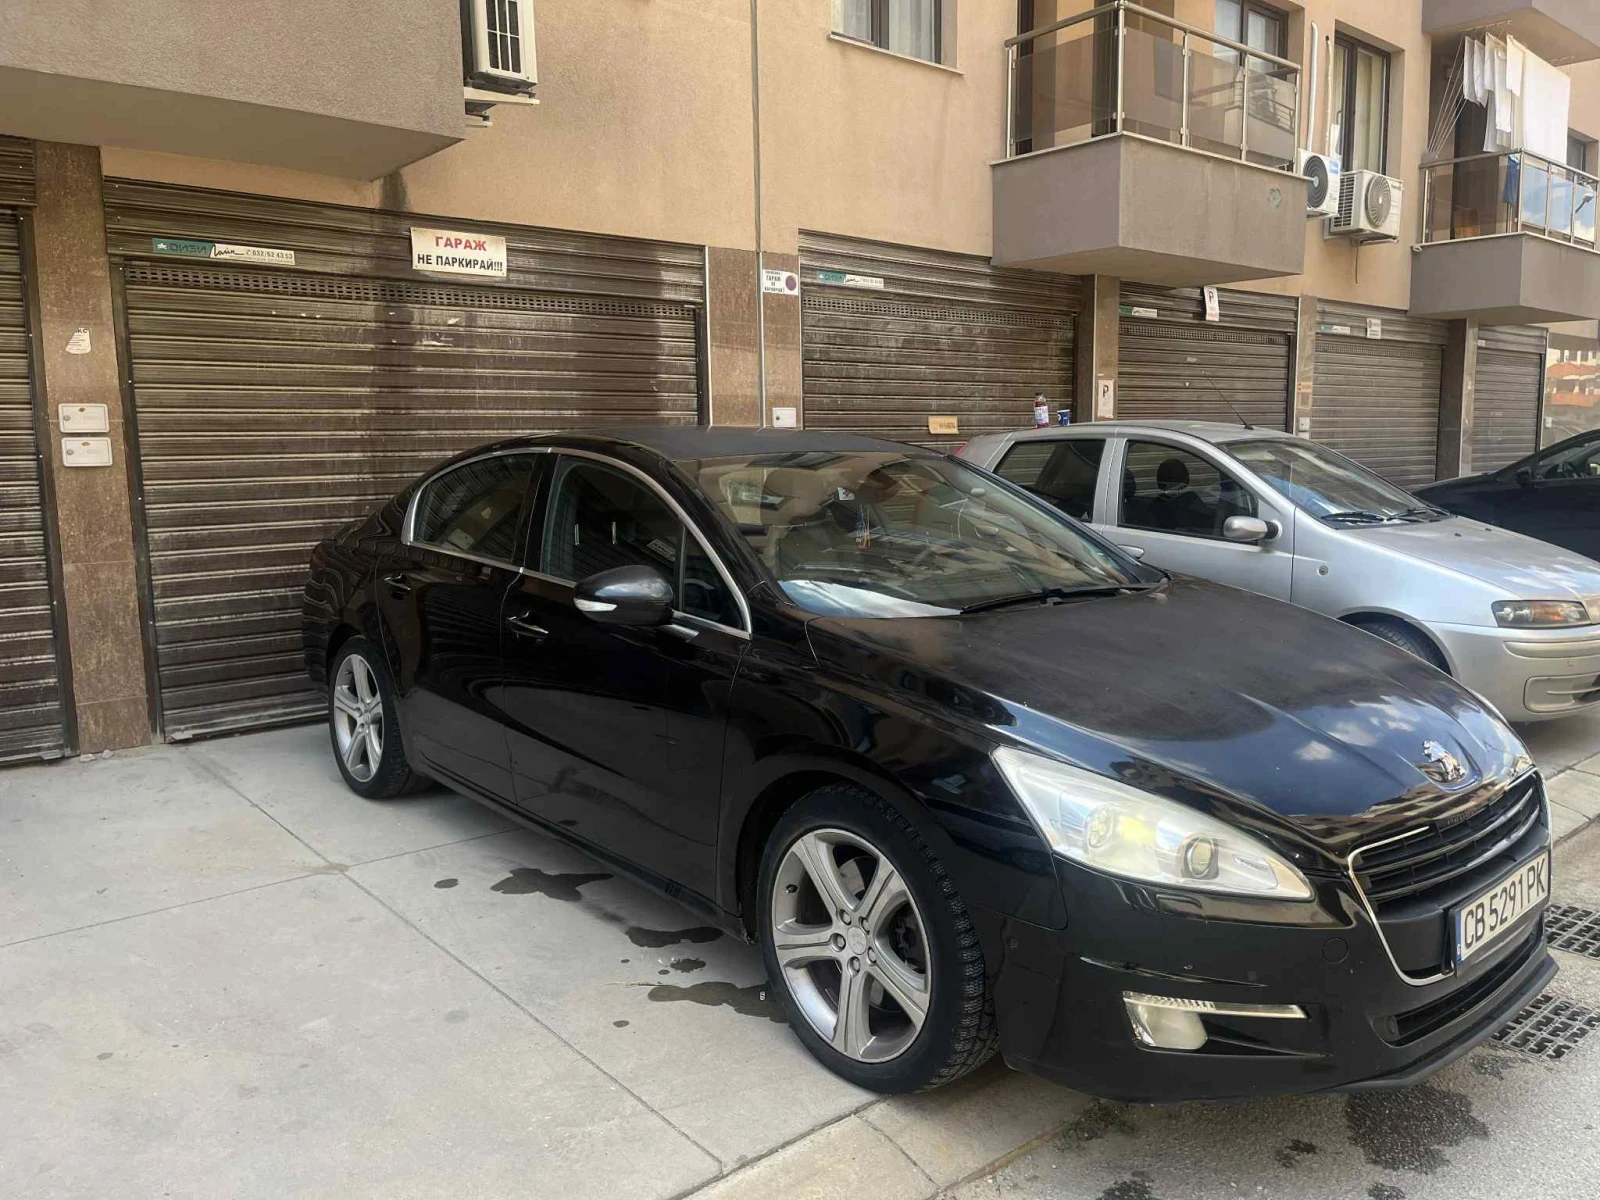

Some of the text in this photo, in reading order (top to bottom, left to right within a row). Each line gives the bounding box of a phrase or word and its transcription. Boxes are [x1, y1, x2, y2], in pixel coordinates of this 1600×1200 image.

[435, 236, 487, 251] ГАРАЖ
[417, 253, 503, 272] НЕ ПАРКИРАЙ!!!
[1102, 384, 1109, 398] P
[1464, 858, 1545, 949] CB 5291 PK
